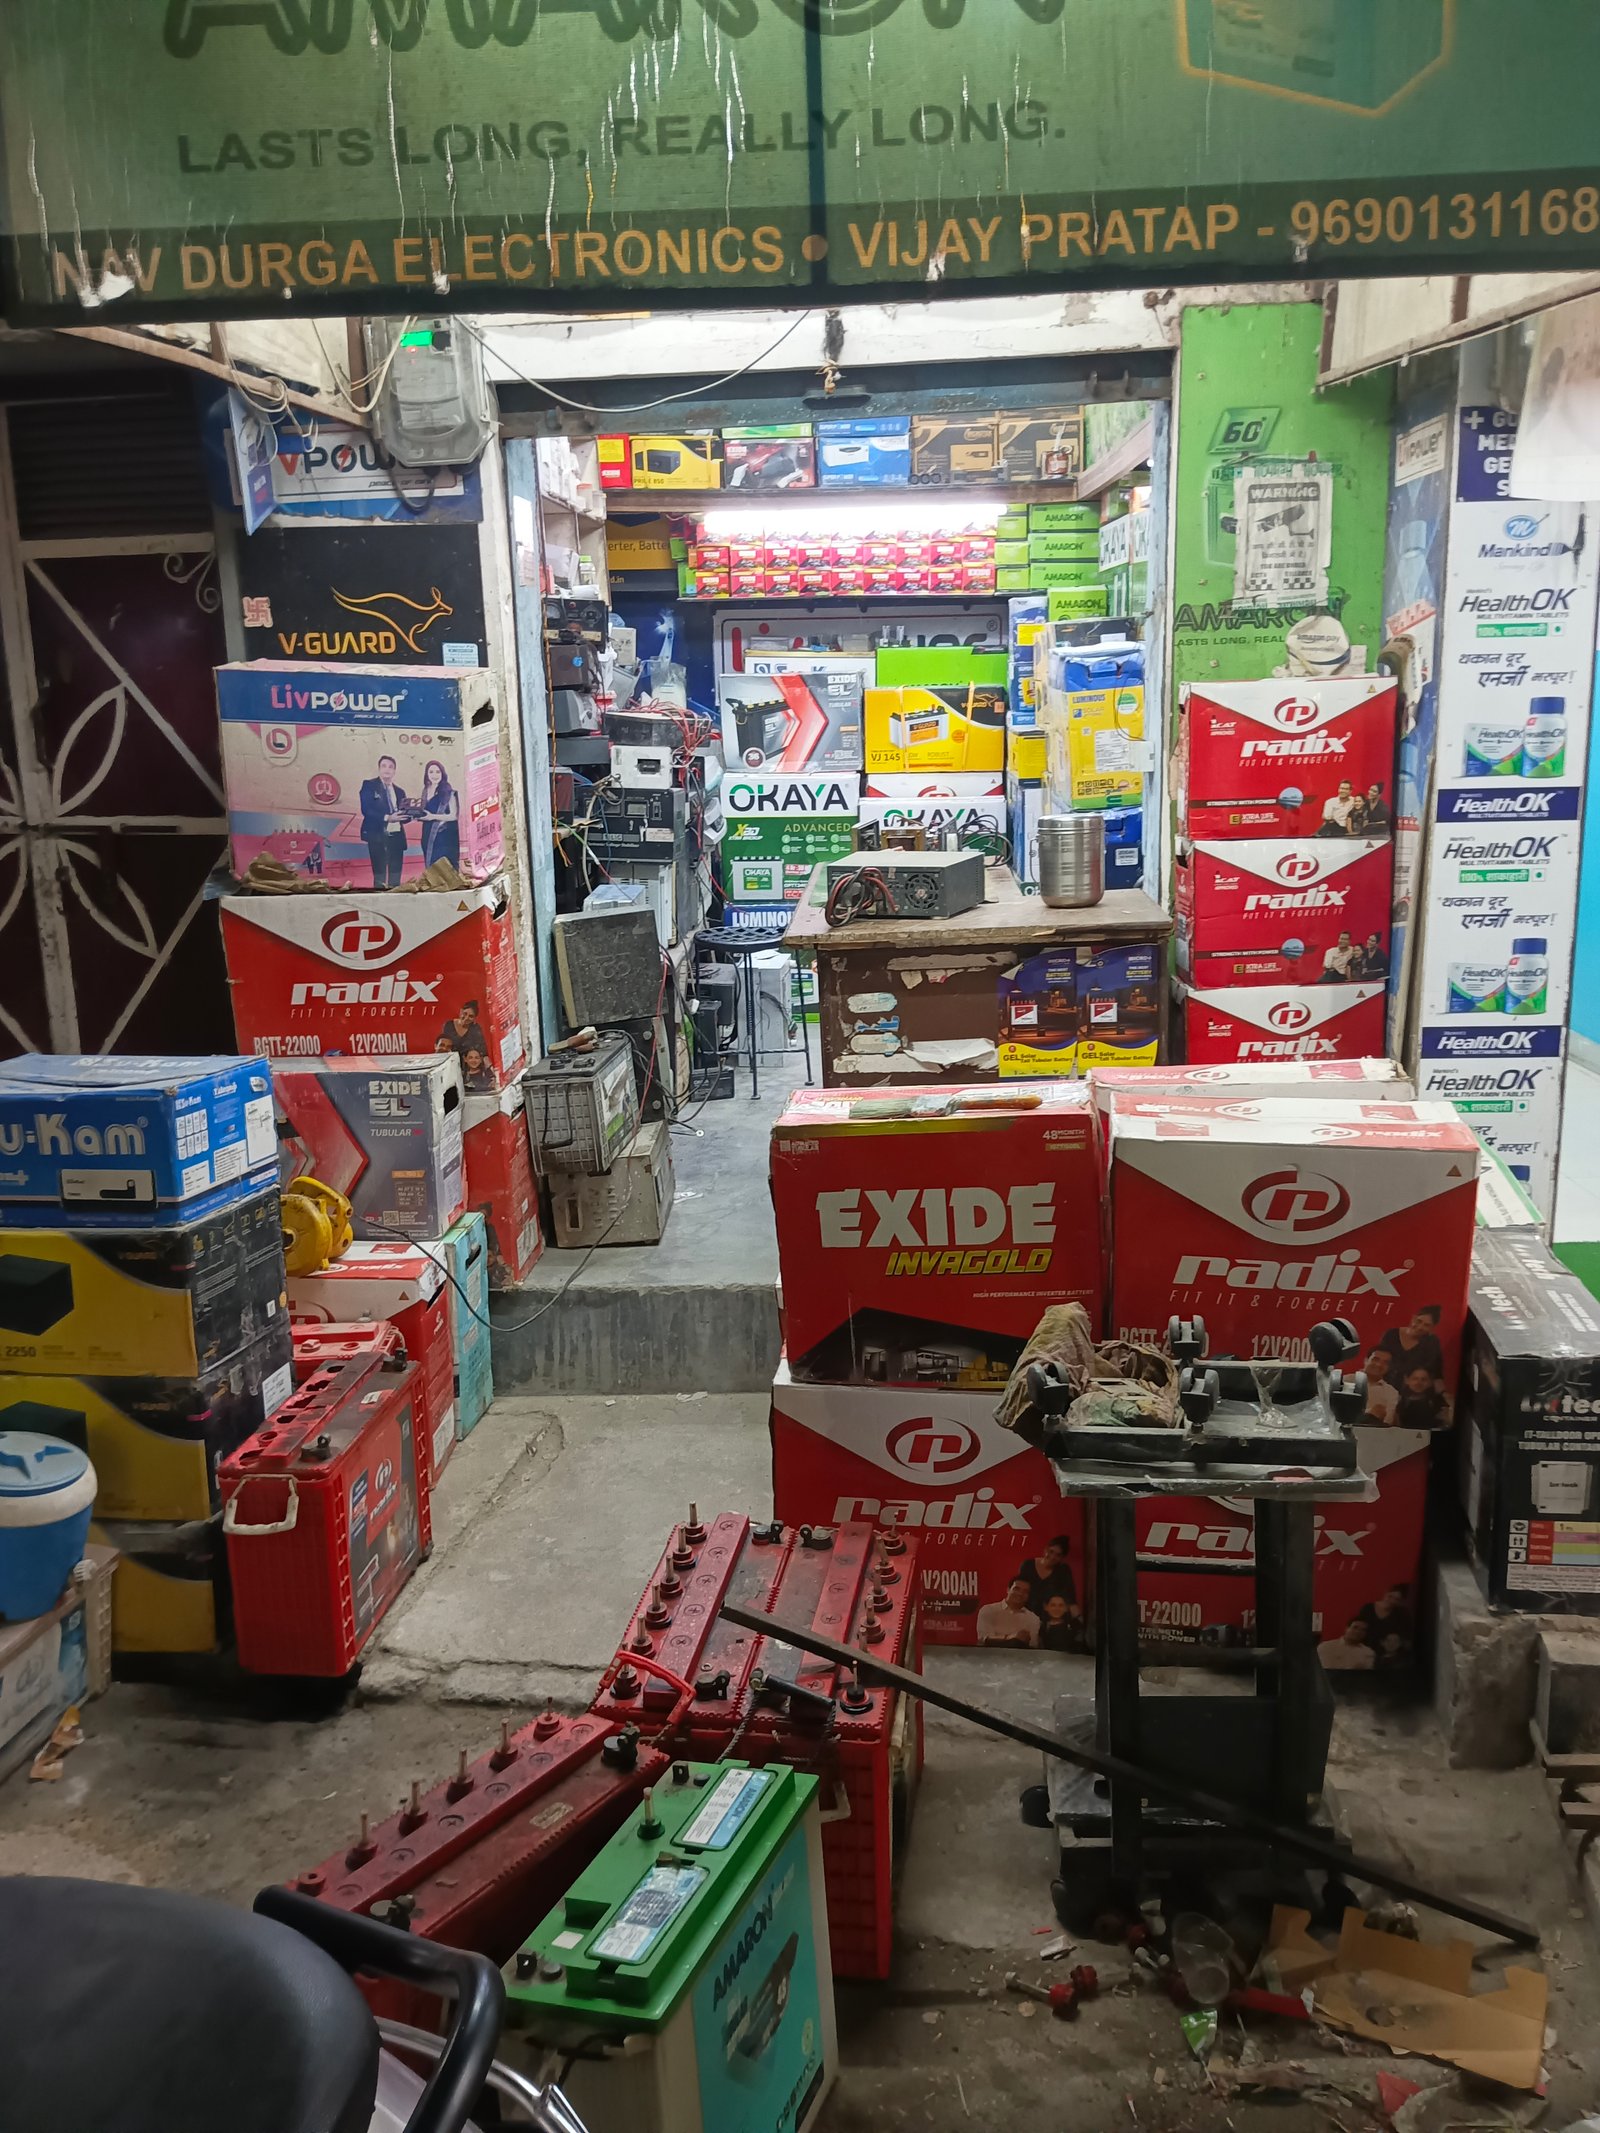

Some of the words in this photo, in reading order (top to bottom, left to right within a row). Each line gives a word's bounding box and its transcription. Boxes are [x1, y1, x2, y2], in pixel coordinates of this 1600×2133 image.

[178, 127, 375, 174] LASTS
[399, 120, 589, 166] LONG,
[613, 109, 852, 156] REALLY
[872, 100, 1066, 148] LONG.
[53, 245, 160, 297] NAV
[182, 241, 379, 291] DURGA
[400, 226, 784, 283] ELECTRONICS
[848, 215, 1002, 269] VIJAY
[1024, 204, 1239, 259] PRATAP
[1291, 186, 1600, 246] 9690131168
[1250, 487, 1318, 499] WARNING
[1045, 513, 1085, 522] AMARON
[1045, 542, 1084, 551] AMARON
[1478, 543, 1551, 559] Mankind
[1044, 573, 1083, 581] AMARON
[1056, 599, 1105, 610] AMARON
[1459, 587, 1577, 613] HealthOK
[278, 632, 396, 655] V-GUARD
[1240, 729, 1348, 758] radix
[884, 753, 901, 761] 145
[729, 783, 849, 811] OKAYA
[1453, 792, 1557, 813] HealthOK
[784, 823, 851, 833] ADVANCED
[1442, 836, 1559, 859] HealthOK
[1244, 883, 1347, 911] radix
[290, 970, 439, 1005] radix
[291, 1008, 312, 1019] FIT
[322, 1007, 335, 1018] IT
[344, 1007, 352, 1017] &
[361, 1006, 415, 1017] FORGET
[423, 1005, 438, 1016] IT
[349, 1033, 408, 1055] 12V200AH
[1237, 1031, 1340, 1057] radix
[1437, 1031, 1539, 1051] HealthOK
[1003, 1054, 1021, 1062] GEL
[1081, 1052, 1099, 1060] GEL
[369, 1080, 421, 1096] EXIDE
[1425, 1069, 1543, 1091] HealthOK
[370, 1128, 412, 1138] TUBULAR
[815, 1182, 1057, 1248] EXIDE
[885, 1249, 1053, 1277] INVAGOLD
[1172, 1248, 1411, 1298] radix
[1169, 1289, 1202, 1304] FIT
[1217, 1292, 1235, 1305] IT
[1250, 1294, 1260, 1307] &
[1276, 1295, 1362, 1313] FORGET
[1373, 1301, 1396, 1316] IT
[1251, 1334, 1316, 1362] 12V200
[832, 1487, 1042, 1530] radix
[924, 1532, 998, 1548] FORGET
[1010, 1535, 1029, 1547] IT
[1144, 1514, 1373, 1556] raix
